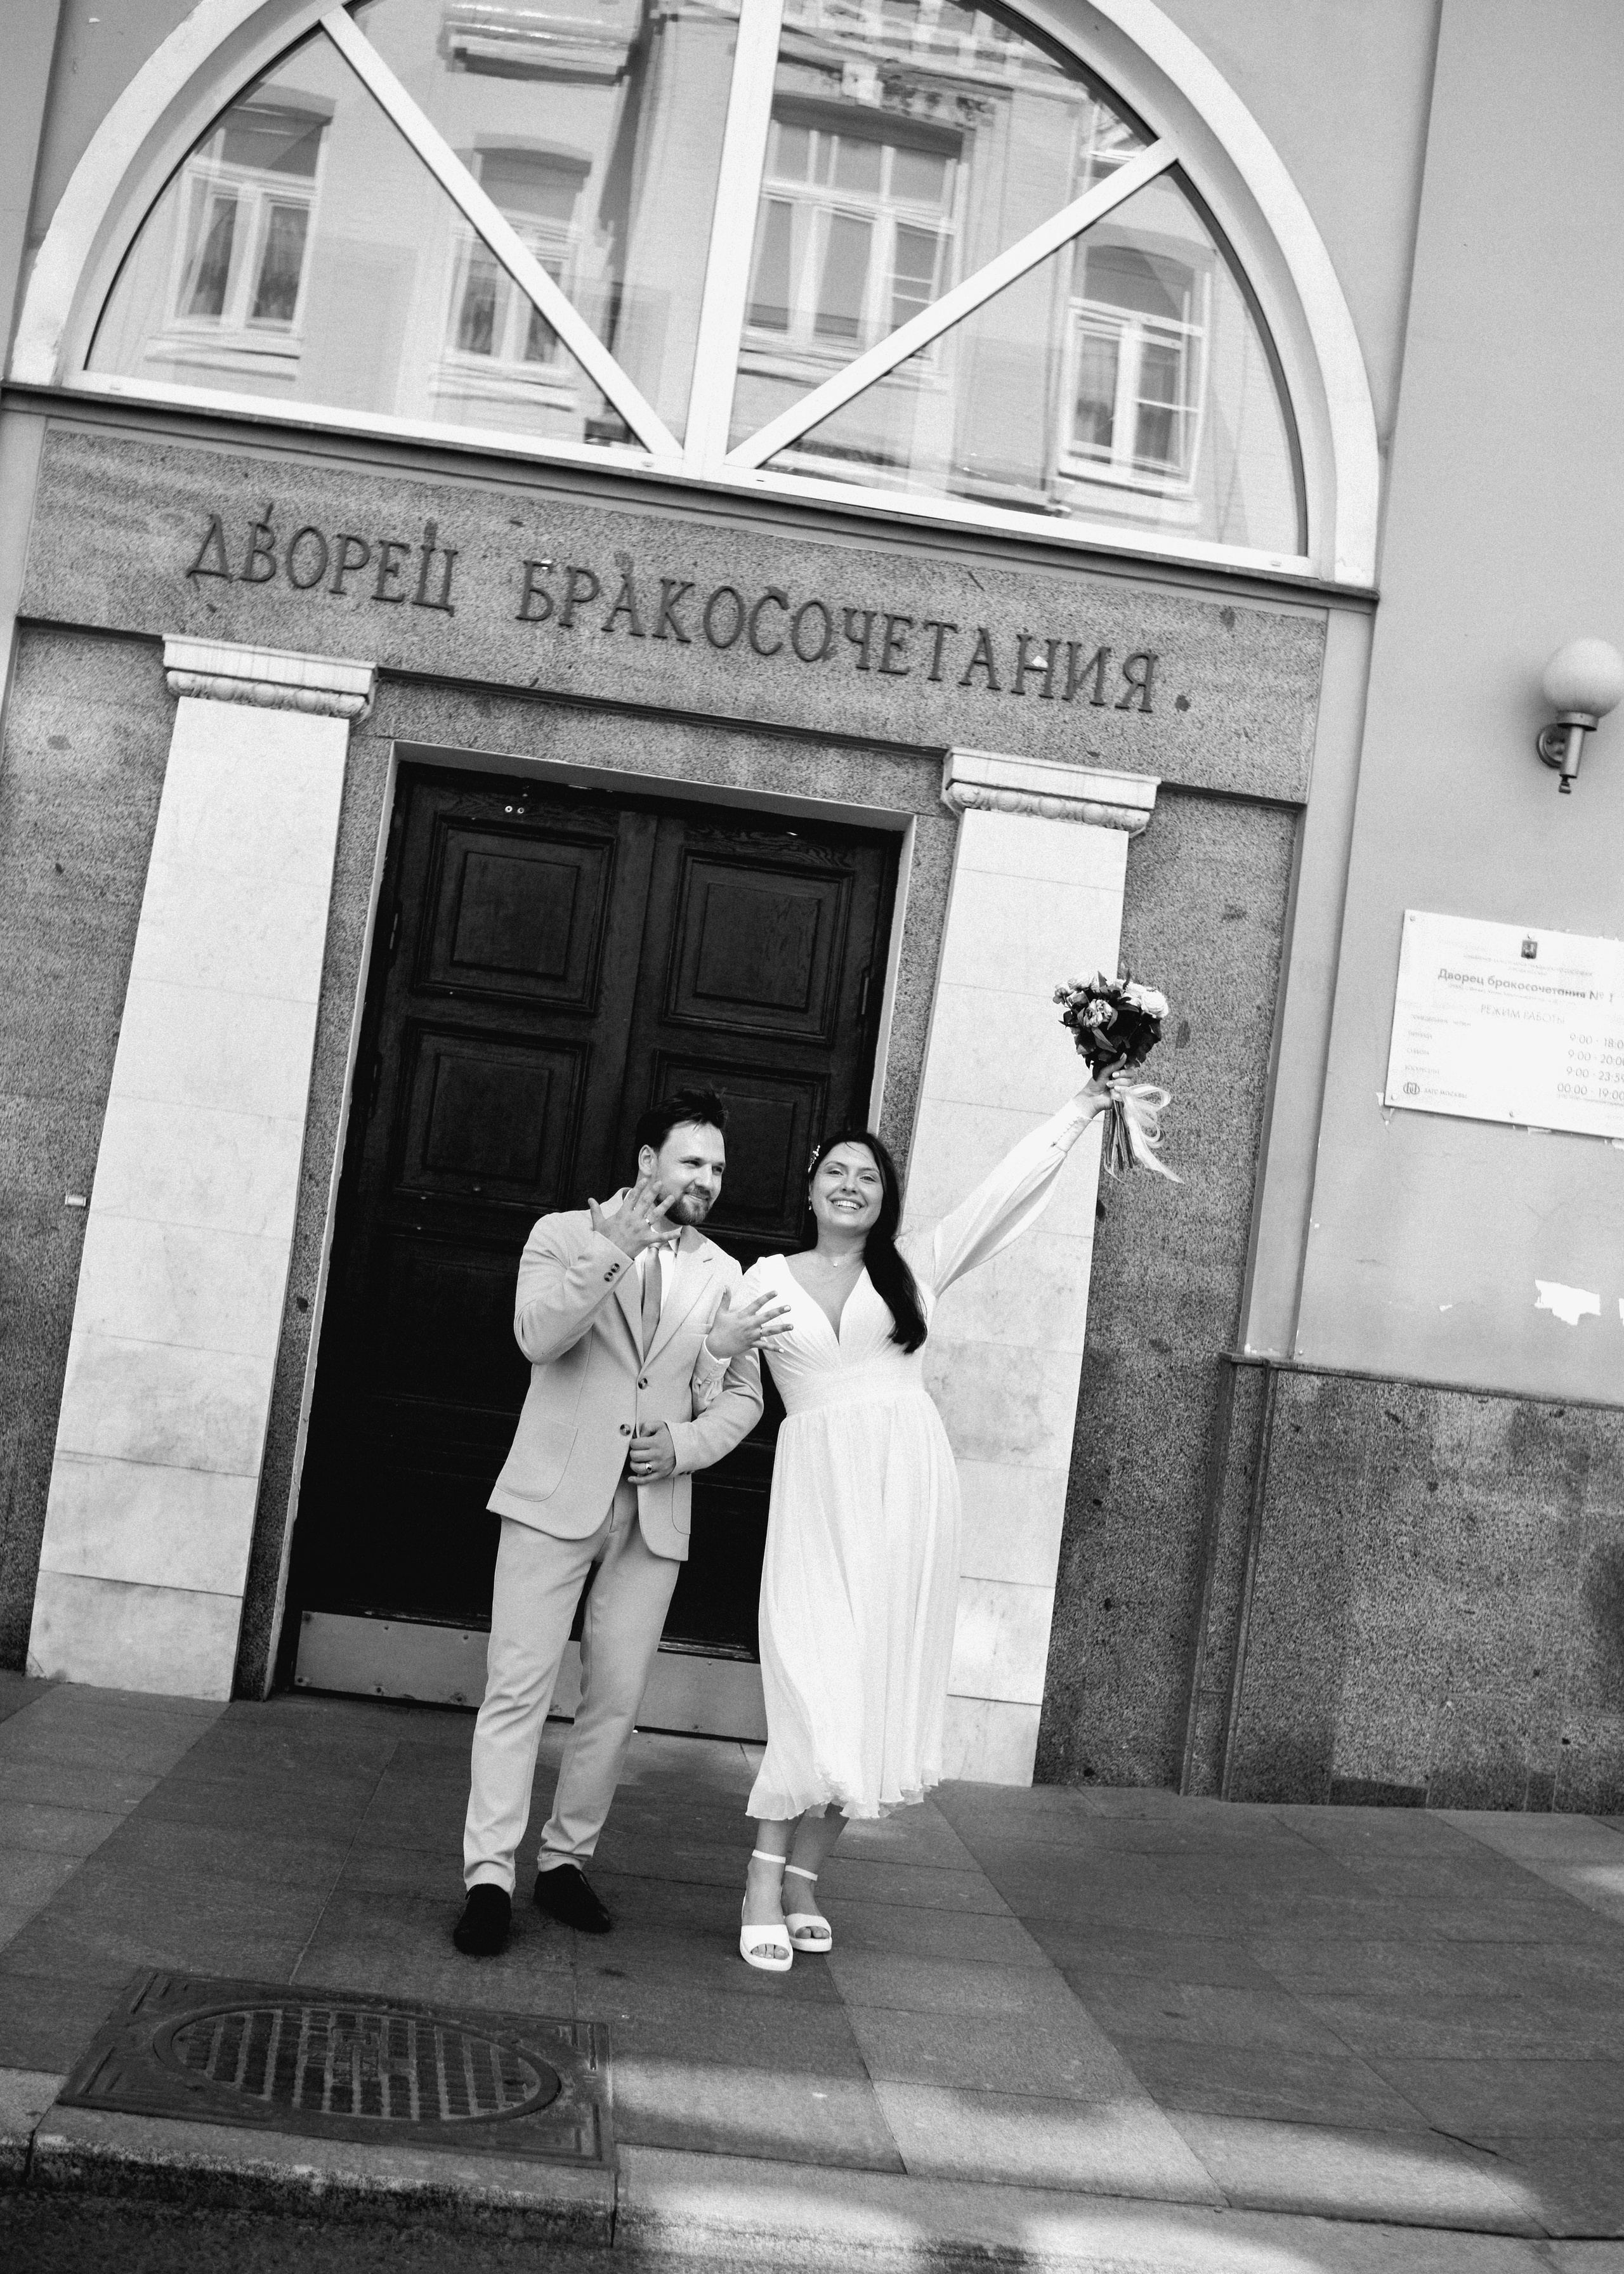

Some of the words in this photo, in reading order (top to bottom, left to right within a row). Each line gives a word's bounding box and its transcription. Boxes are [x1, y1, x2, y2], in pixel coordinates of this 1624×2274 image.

[186, 513, 459, 617] ДВОРЕЦ
[515, 559, 1159, 713] БРАКОСОЧЕТАНИЯ
[1437, 968, 1484, 986] Дворец
[1488, 975, 1585, 999] бракосочетания
[1481, 1003, 1521, 1019] РЕЖИМ
[1523, 1010, 1565, 1025] РАБОТЫ
